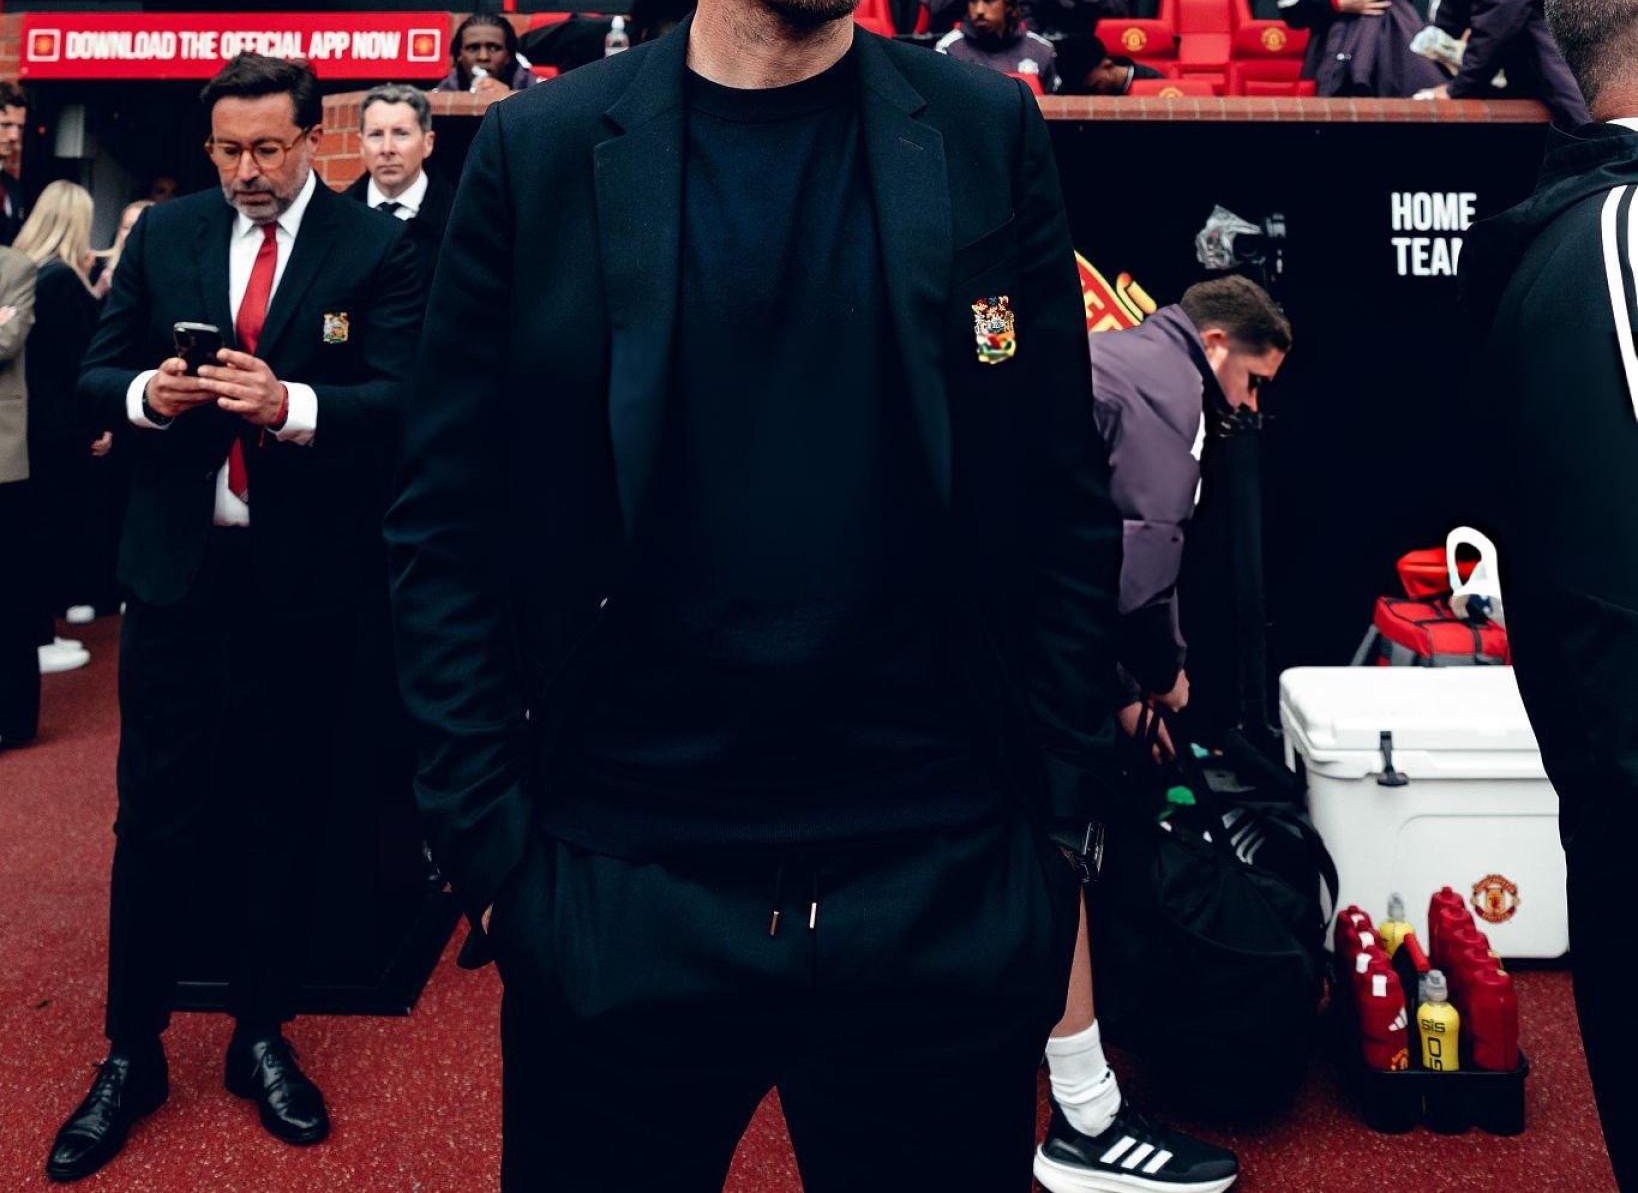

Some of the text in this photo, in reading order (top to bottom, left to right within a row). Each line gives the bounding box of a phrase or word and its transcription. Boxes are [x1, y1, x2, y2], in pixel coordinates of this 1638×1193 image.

[65, 31, 401, 60] DOWNLOAD THE OFFICIAL APP NOW
[1391, 191, 1477, 231] HOME
